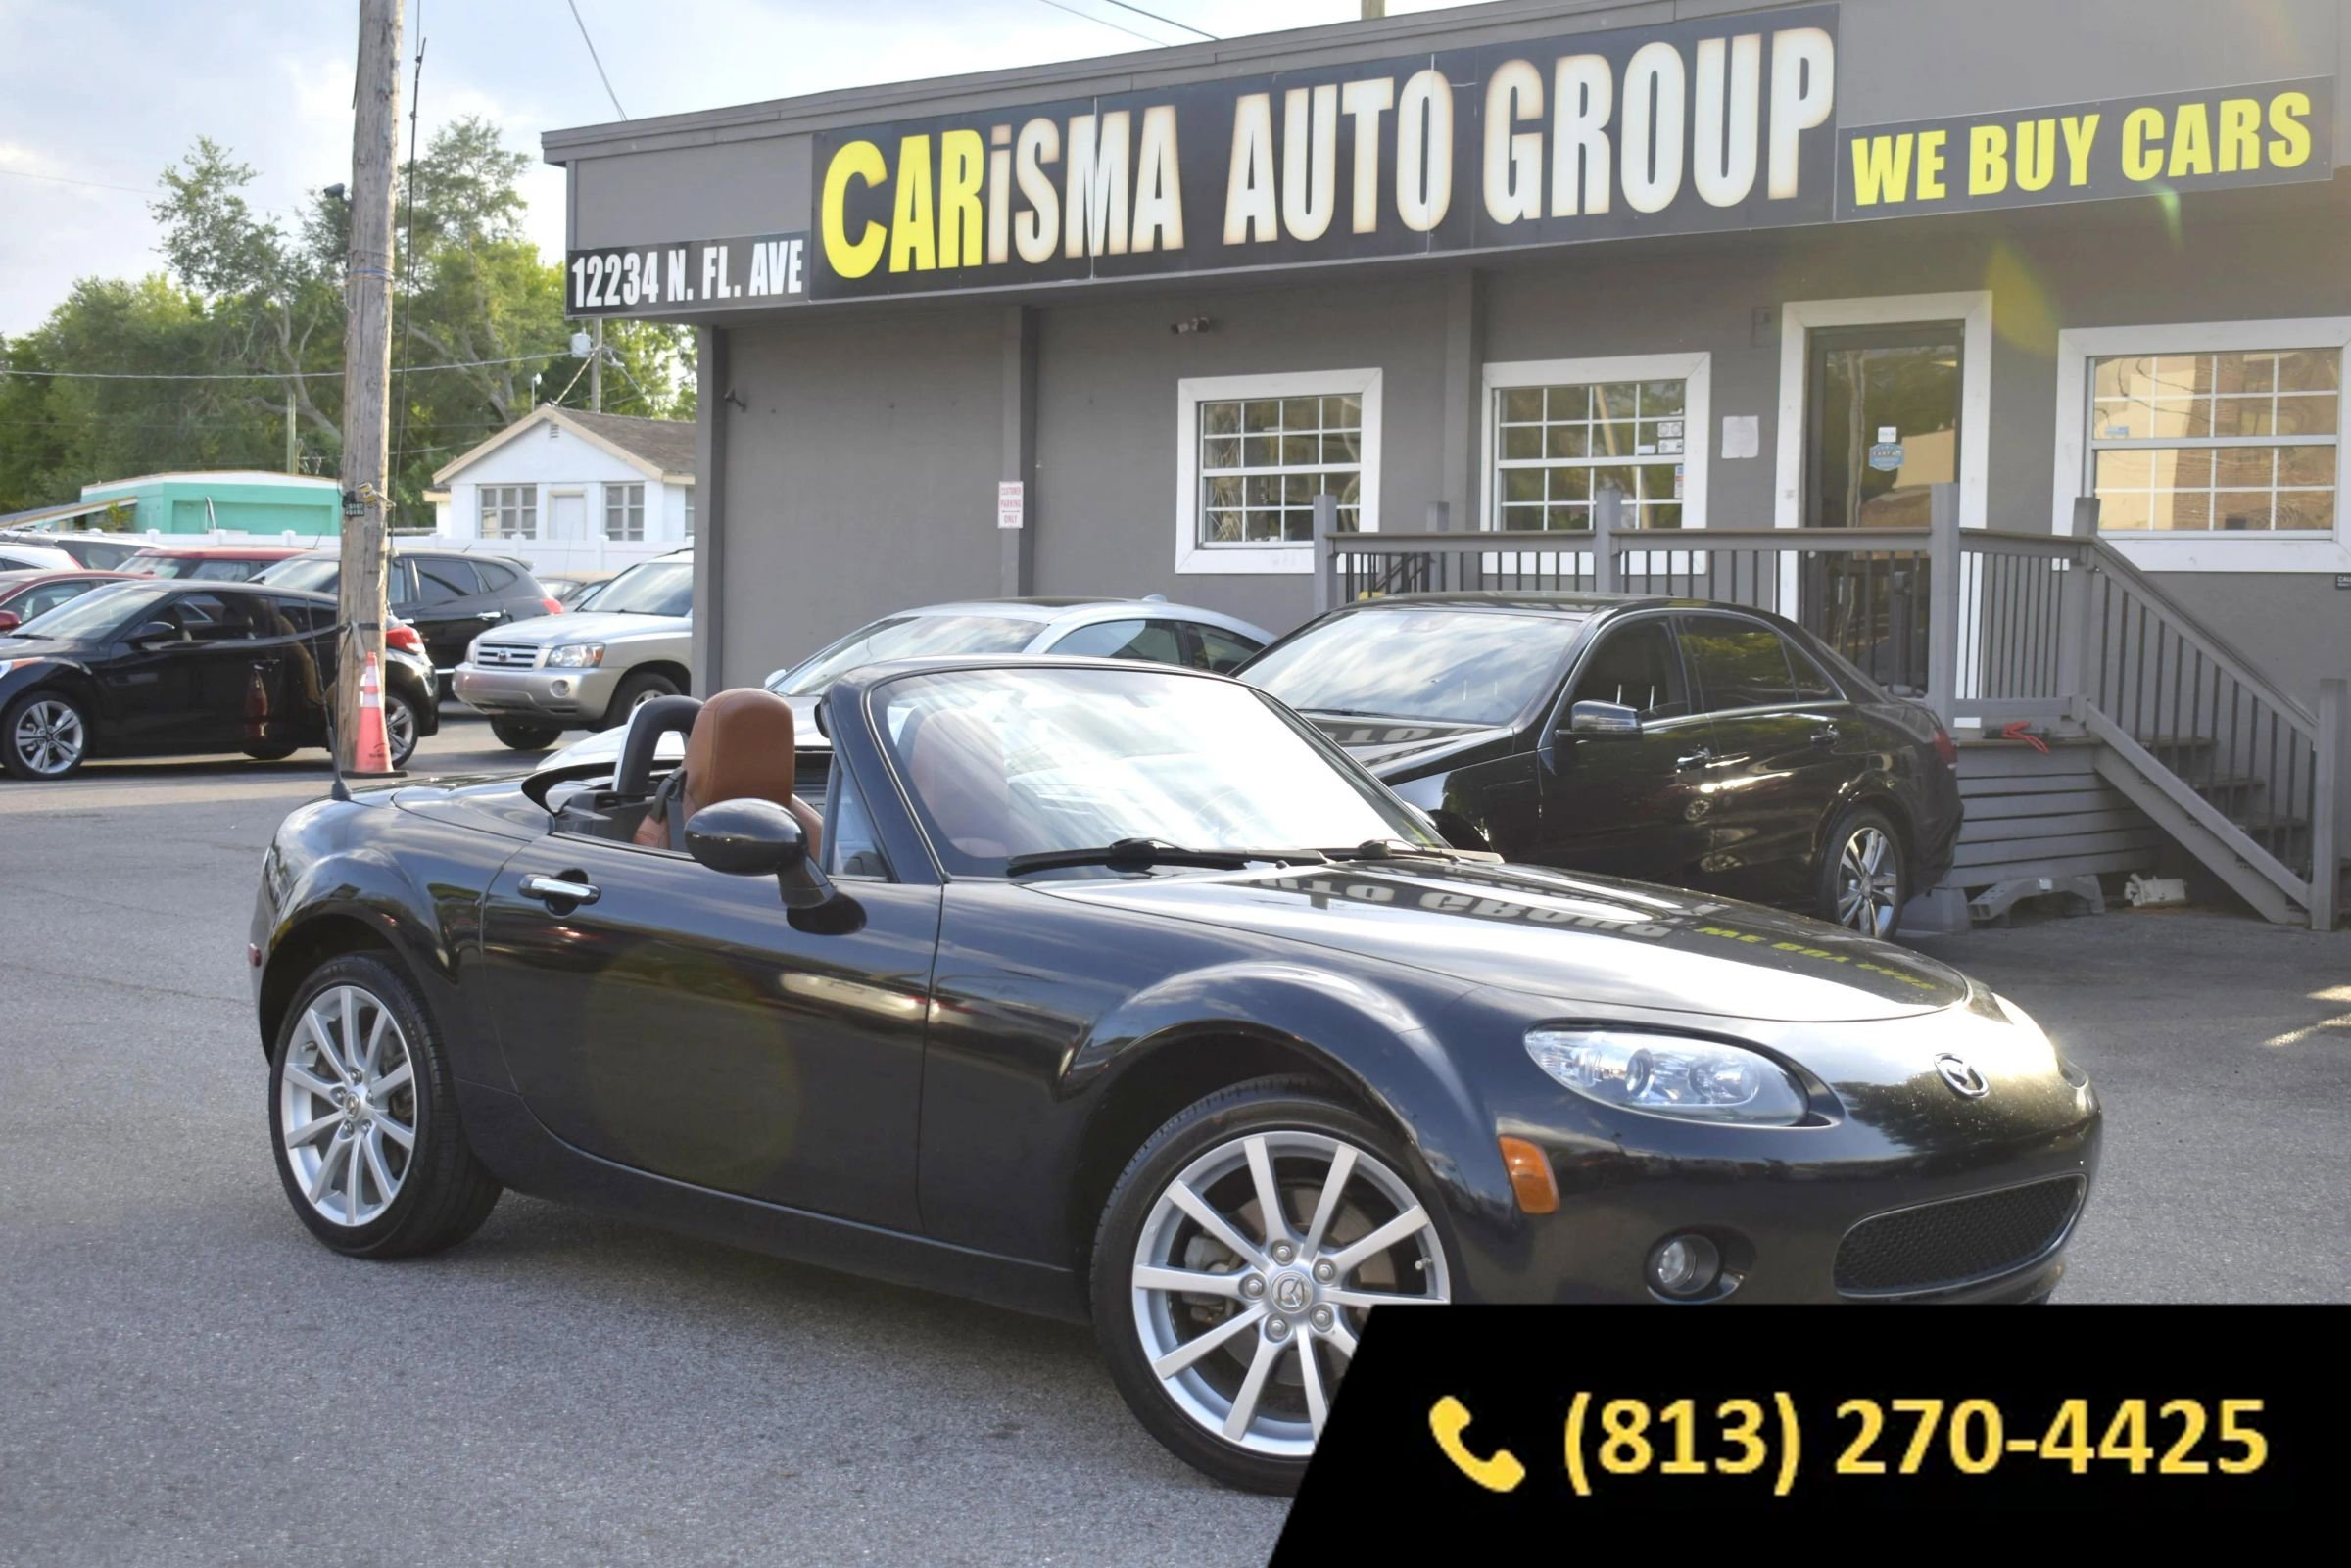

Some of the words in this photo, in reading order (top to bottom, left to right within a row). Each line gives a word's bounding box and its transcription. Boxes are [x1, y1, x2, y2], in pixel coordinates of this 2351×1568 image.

[1223, 70, 1454, 245] AUTO
[1483, 27, 1834, 225] GROUP
[1851, 130, 1946, 206] WE
[1968, 114, 2100, 195] BUY
[2122, 92, 2311, 182] CARS
[571, 251, 658, 308] 12234
[668, 248, 694, 301] N.
[702, 240, 741, 298] FL.
[748, 239, 803, 295] AVE
